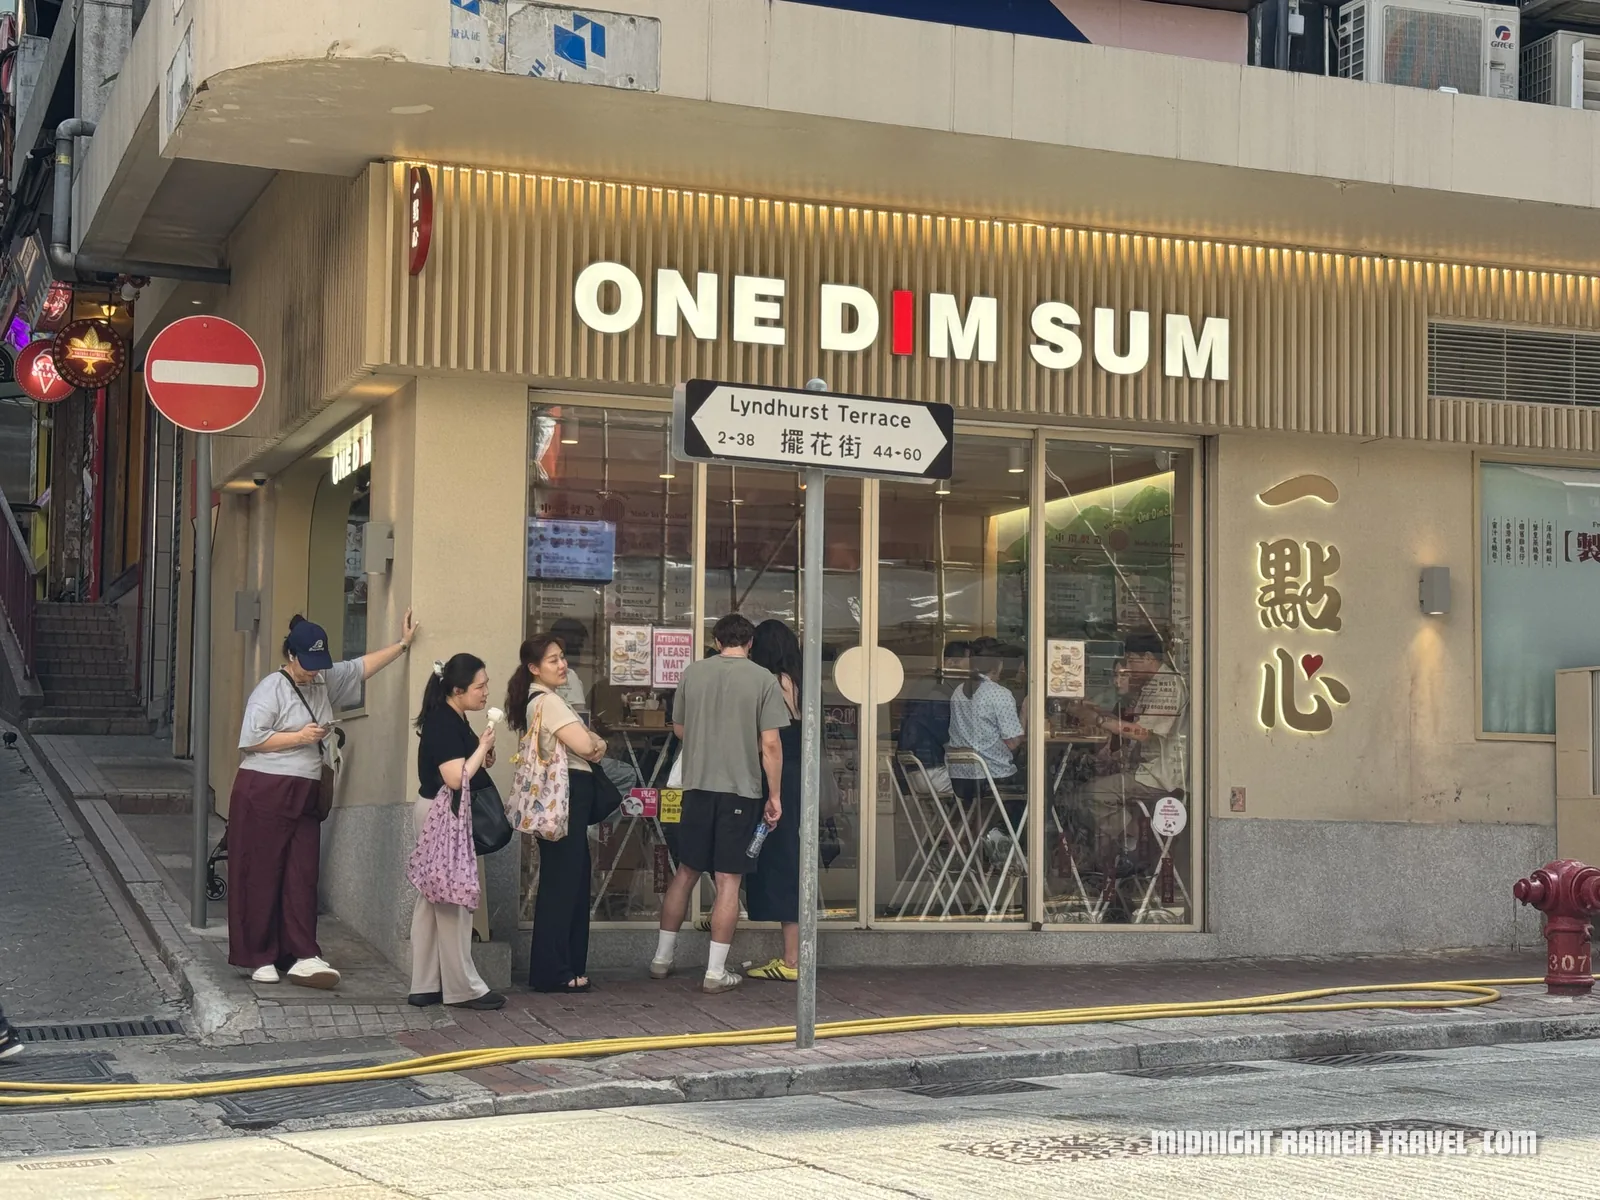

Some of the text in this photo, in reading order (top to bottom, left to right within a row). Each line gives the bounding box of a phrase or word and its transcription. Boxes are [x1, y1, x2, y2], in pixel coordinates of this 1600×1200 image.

[1490, 41, 1515, 50] GREE
[575, 262, 1229, 380] ONE DIM SUM
[730, 394, 911, 428] Lyndhurst Terrace
[780, 428, 862, 460] 擺花街
[332, 446, 352, 485] ONE
[1256, 473, 1351, 732] 一點心
[657, 635, 689, 643] ATTENTION
[657, 646, 690, 657] PLEASE
[663, 659, 685, 669] WAIT
[1549, 954, 1587, 973] 307
